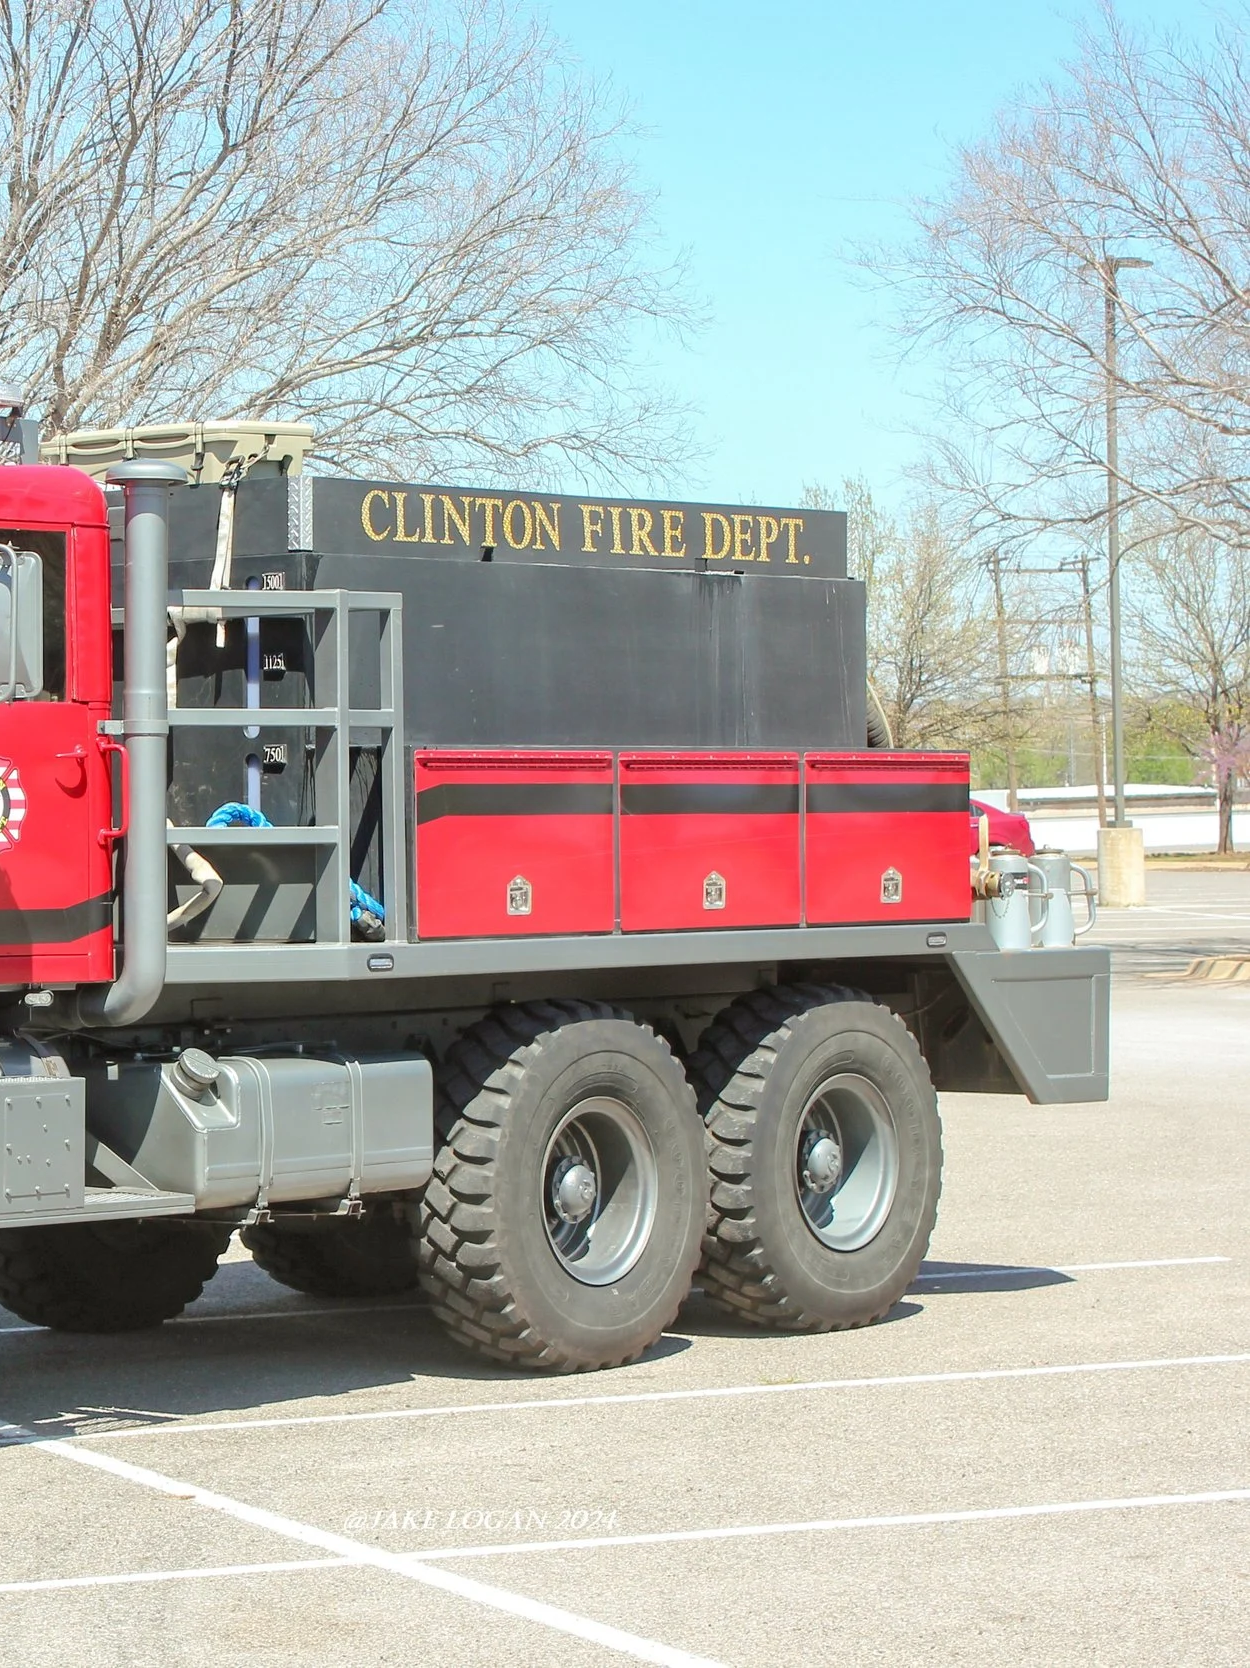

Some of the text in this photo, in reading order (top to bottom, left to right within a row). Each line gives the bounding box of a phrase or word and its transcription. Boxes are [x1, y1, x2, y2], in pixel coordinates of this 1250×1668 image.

[360, 488, 811, 565] CLINTON FIRE DEPT.
